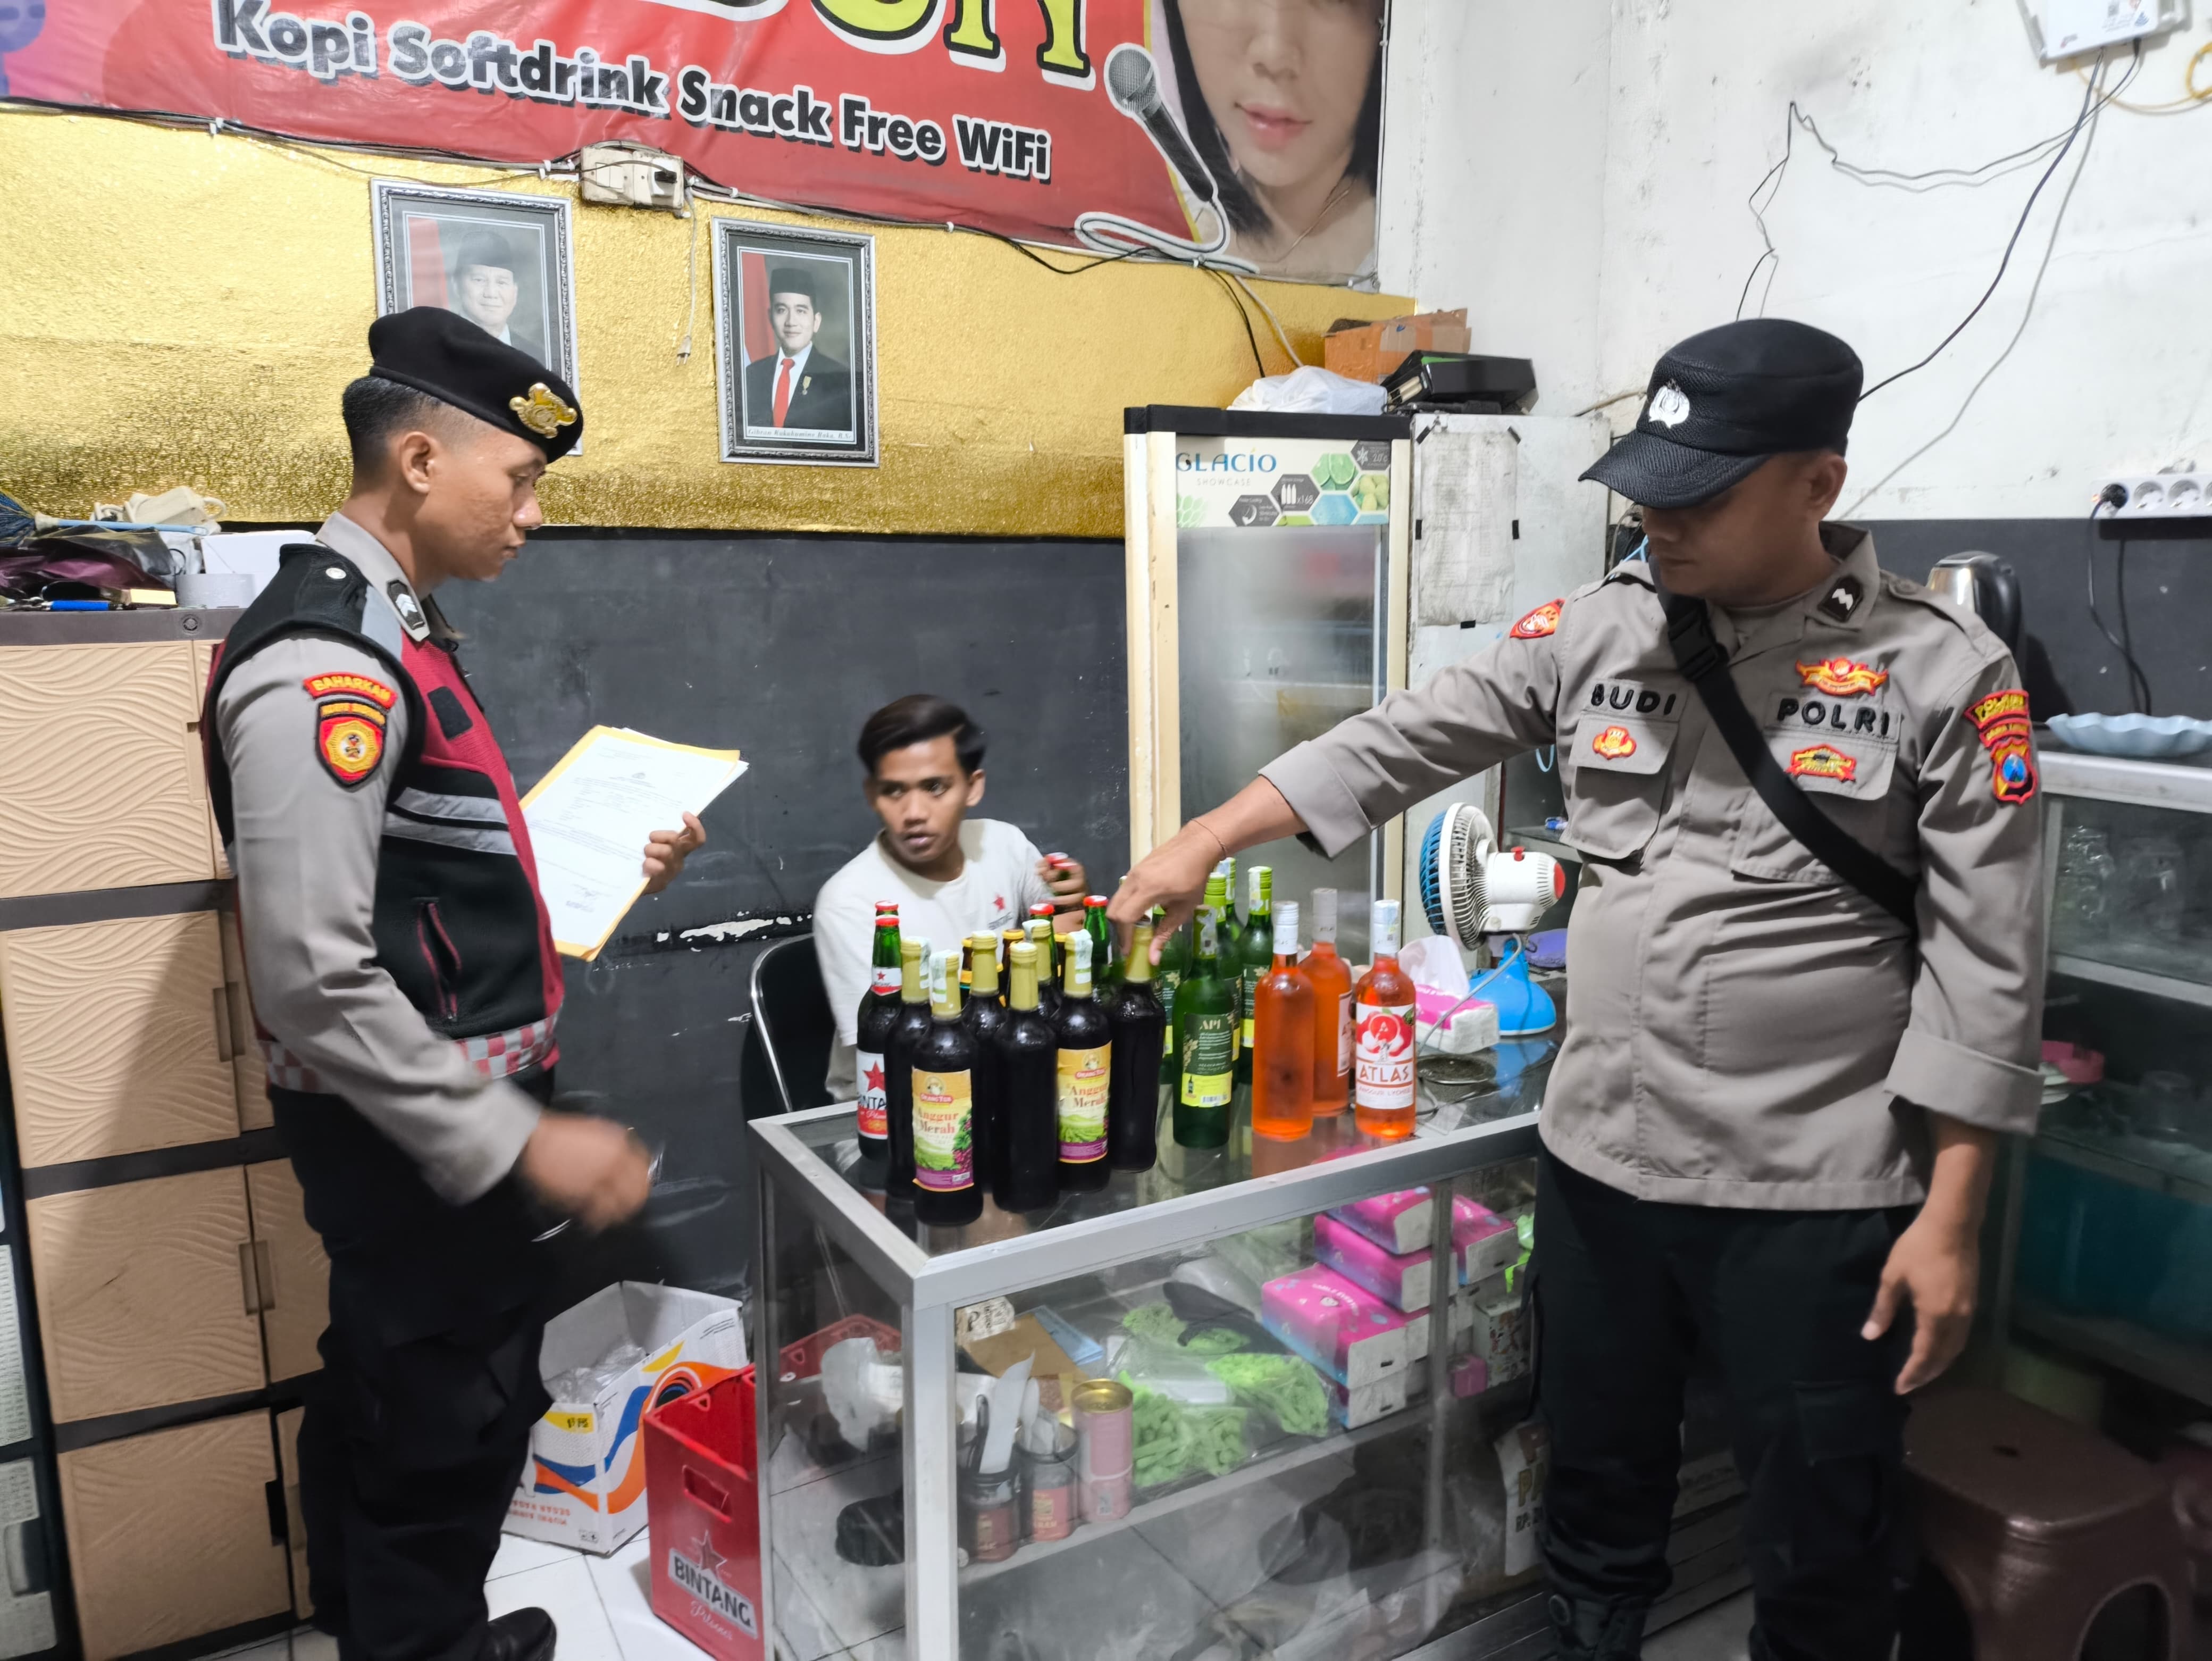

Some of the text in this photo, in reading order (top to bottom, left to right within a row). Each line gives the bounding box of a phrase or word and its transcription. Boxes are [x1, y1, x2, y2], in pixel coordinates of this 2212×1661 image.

[215, 0, 1049, 178] Kopi Softdrink Snack Free WiFi
[1197, 478, 1251, 487] SHOWCASE
[1776, 697, 1890, 736] POLRI
[1199, 1019, 1221, 1030] API
[1359, 1064, 1410, 1083] ATLAS
[918, 1107, 959, 1122] Anggur
[919, 1119, 956, 1134] Merah
